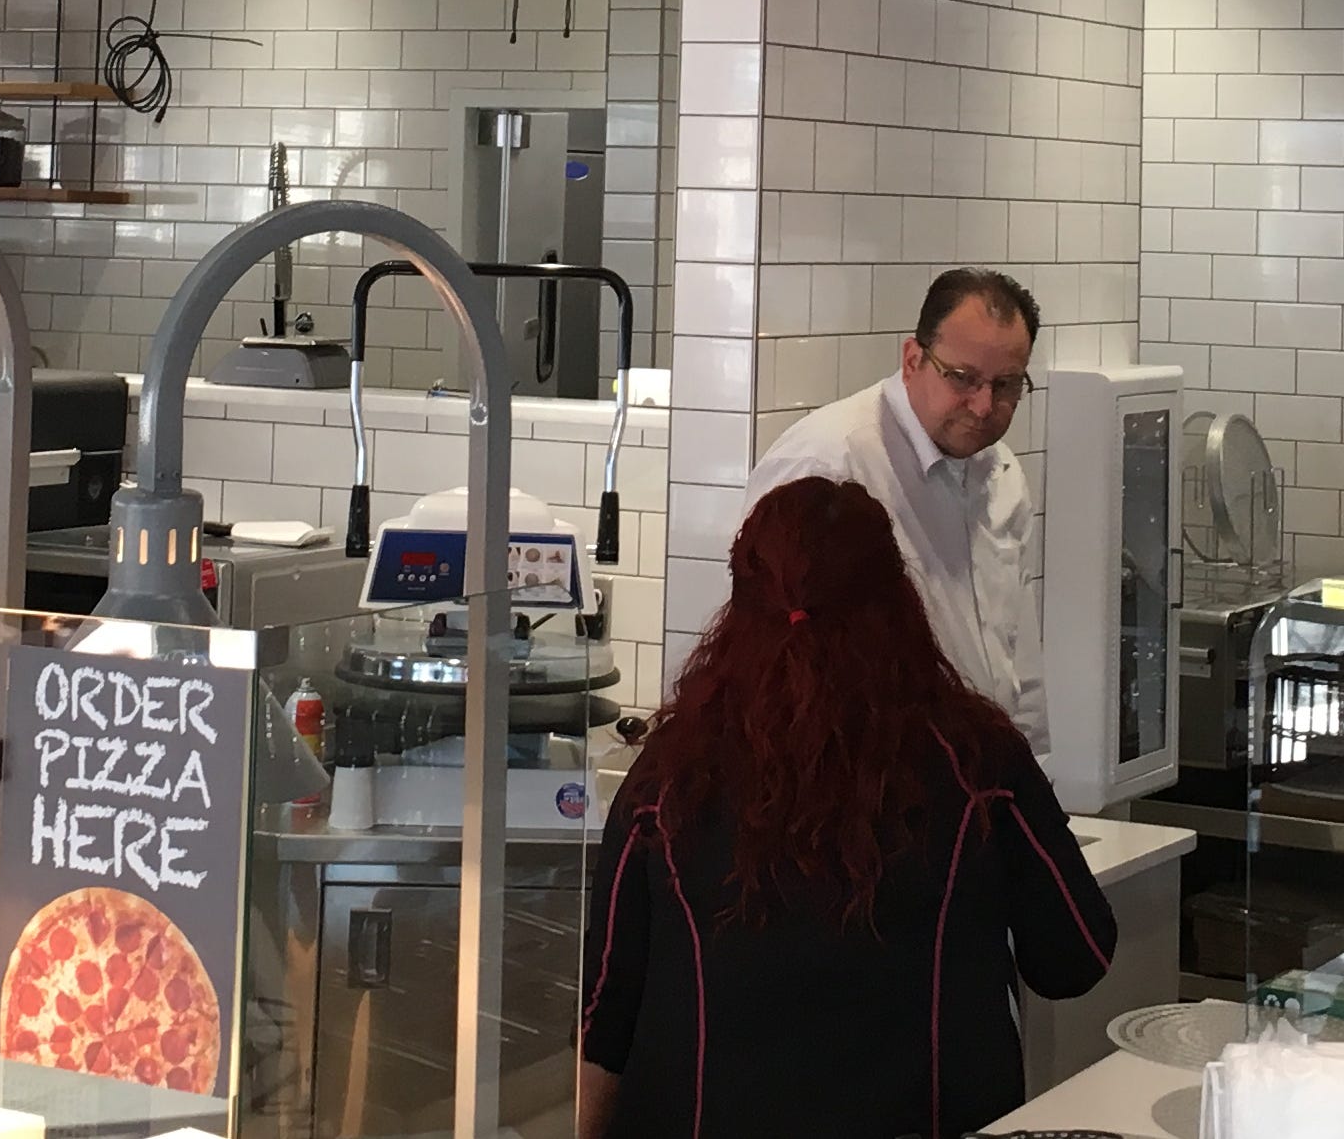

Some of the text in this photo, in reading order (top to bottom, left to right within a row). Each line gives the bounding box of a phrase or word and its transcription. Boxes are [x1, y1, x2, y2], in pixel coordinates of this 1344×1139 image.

[35, 662, 218, 744] ORDER
[34, 728, 211, 809] PIZZA
[32, 793, 209, 891] HERE
